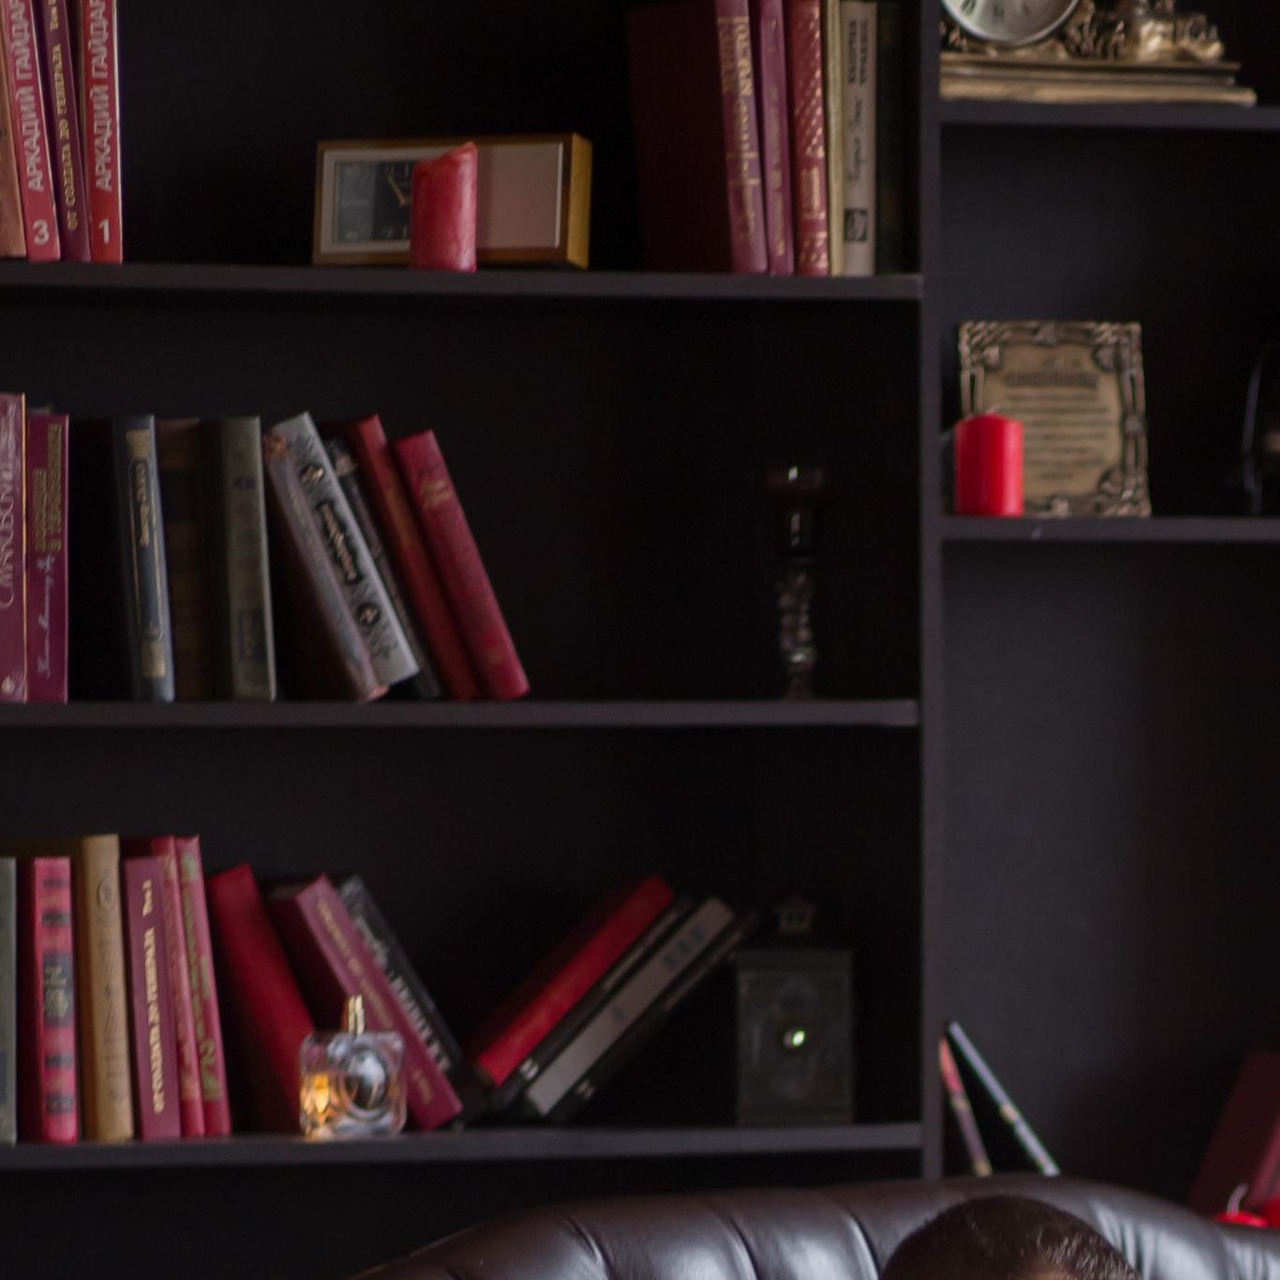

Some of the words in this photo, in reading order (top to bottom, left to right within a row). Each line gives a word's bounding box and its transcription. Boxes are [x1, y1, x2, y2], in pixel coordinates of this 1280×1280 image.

[16, 86, 45, 193] АРКАДИЙ
[89, 85, 113, 193] АРКАДИЙ
[32, 218, 50, 246] 3
[98, 218, 111, 245] 1
